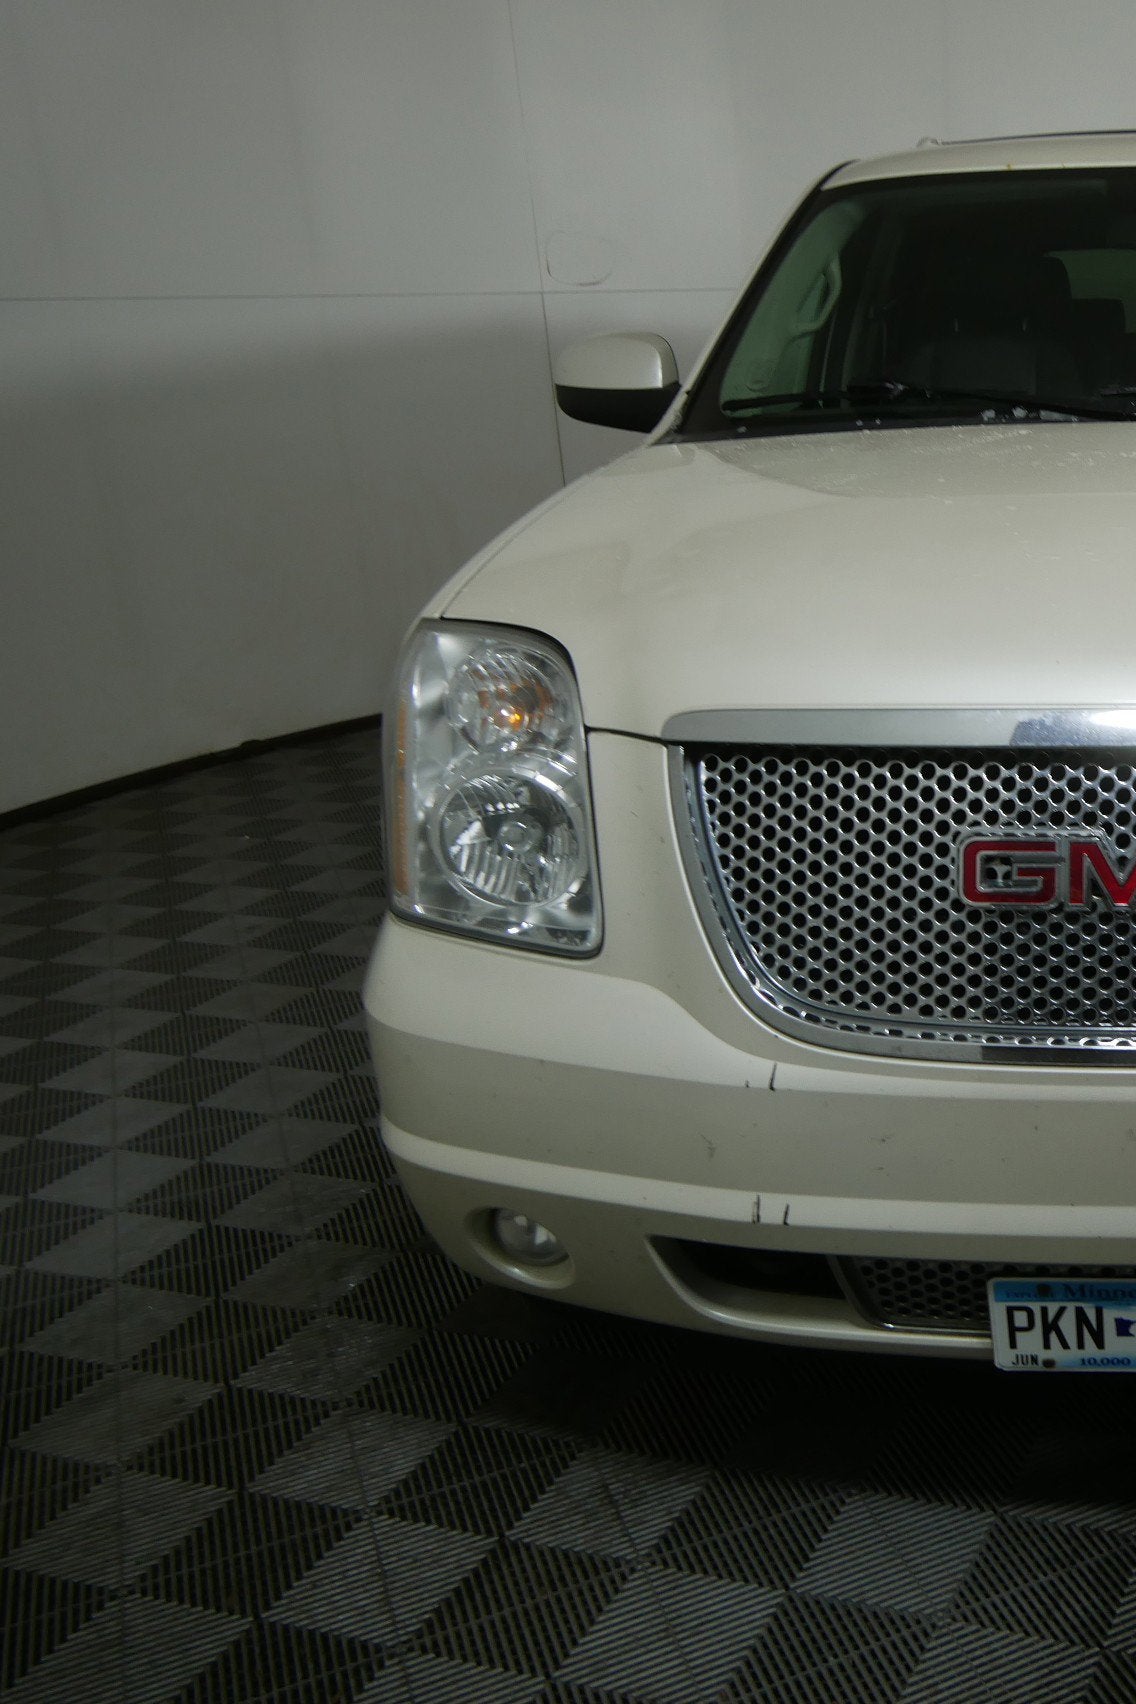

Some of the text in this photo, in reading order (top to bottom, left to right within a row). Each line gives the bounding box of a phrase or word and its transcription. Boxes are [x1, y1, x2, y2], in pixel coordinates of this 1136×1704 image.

[1006, 1305, 1105, 1350] PKN
[1012, 1354, 1039, 1366] JUN
[1080, 1356, 1131, 1368] 10,000
